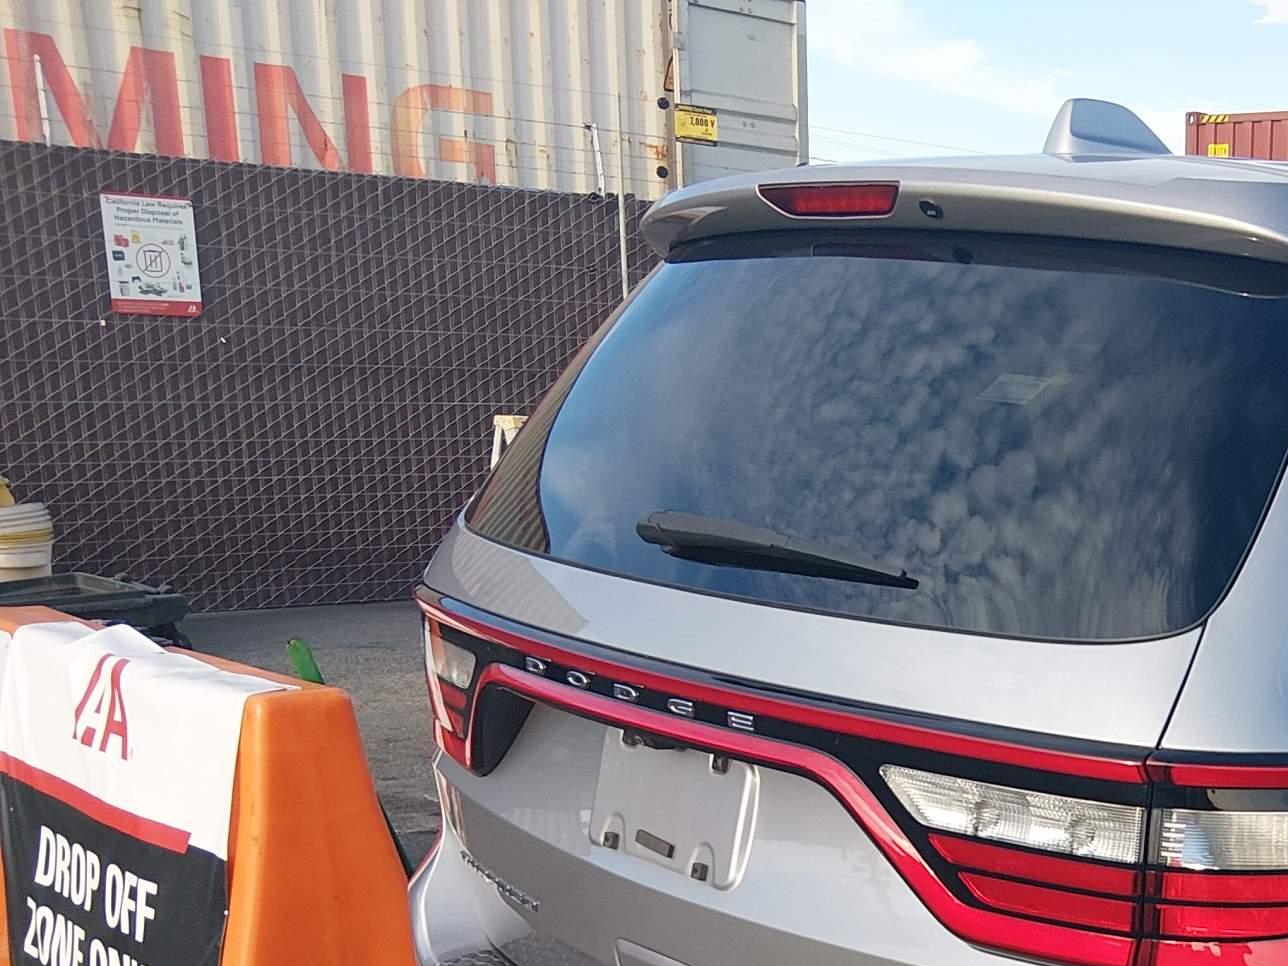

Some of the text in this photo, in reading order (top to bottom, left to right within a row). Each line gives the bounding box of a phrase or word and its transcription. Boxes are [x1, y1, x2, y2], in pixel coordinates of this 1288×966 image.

[6, 28, 496, 186] MING
[105, 198, 140, 206] California
[117, 206, 139, 214] Proper
[141, 209, 171, 217] Disposal
[525, 656, 755, 732] DODGE
[35, 825, 158, 943] DROP OFF
